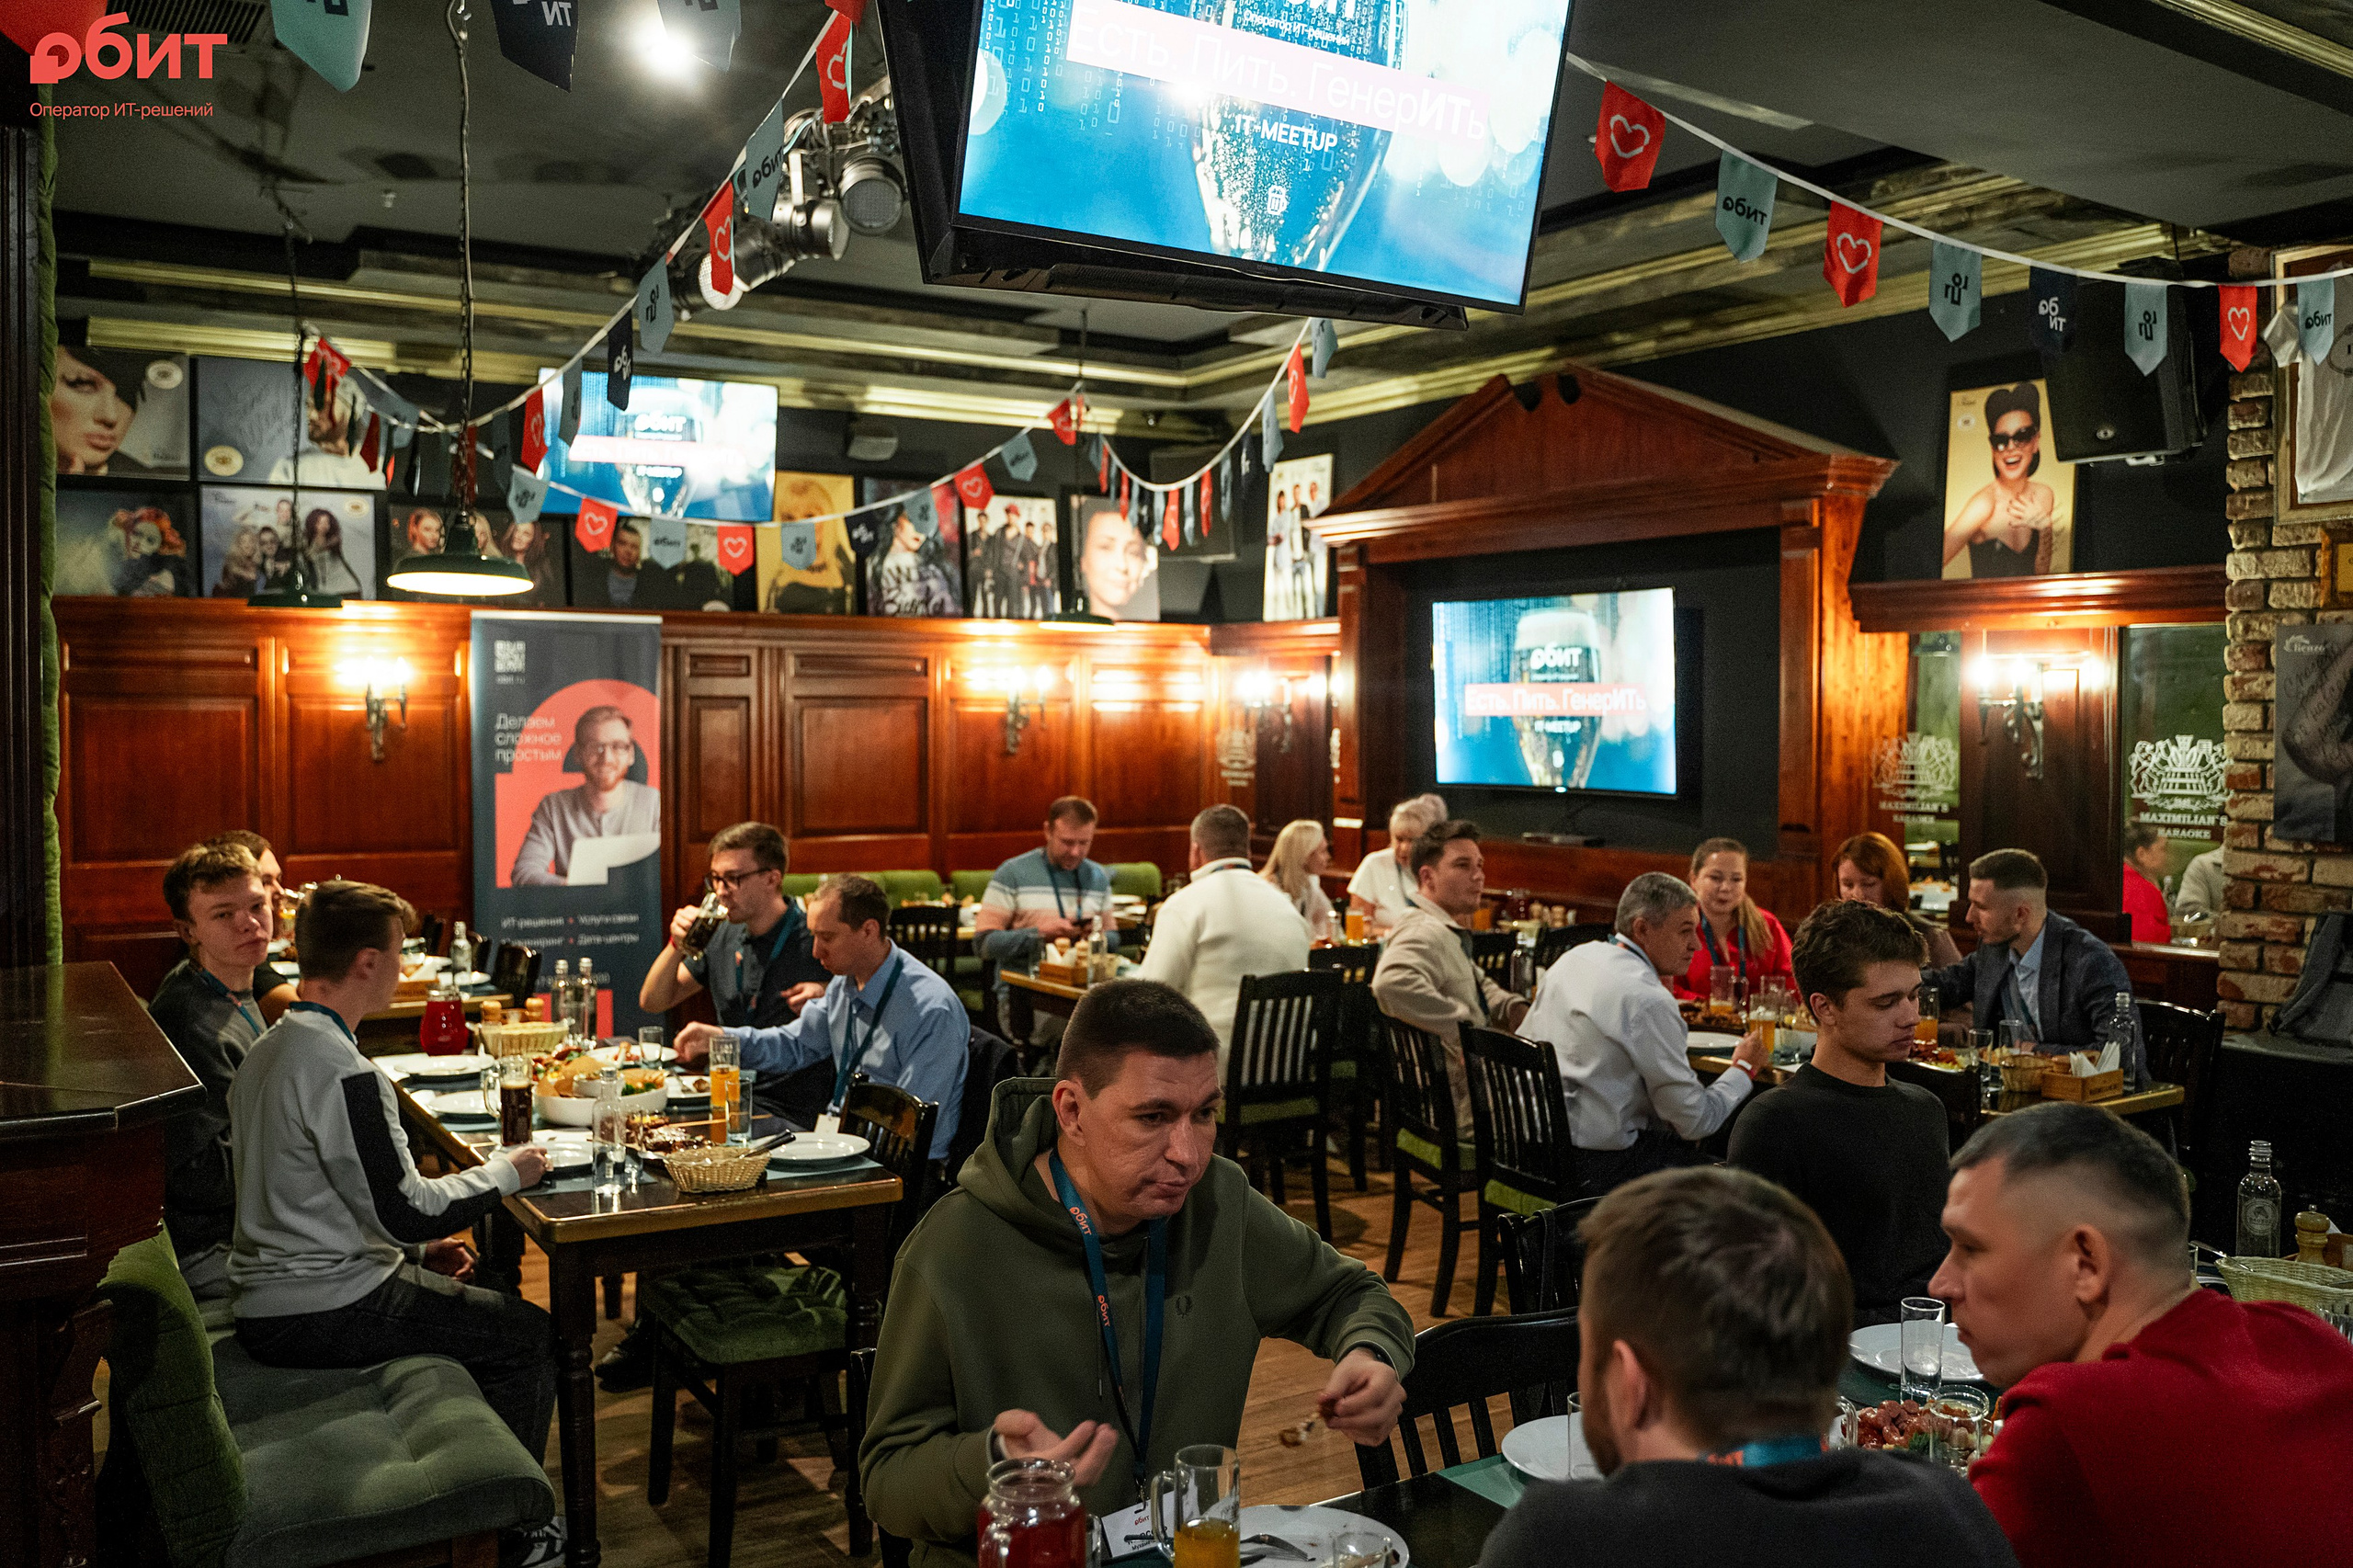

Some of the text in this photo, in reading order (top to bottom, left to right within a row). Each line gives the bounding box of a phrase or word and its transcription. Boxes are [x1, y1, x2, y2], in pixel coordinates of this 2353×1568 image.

[1243, 9, 1292, 33] Оператор
[1292, 21, 1351, 47] ИТ-решений
[1233, 112, 1339, 153] IT-MEETUP
[1722, 195, 1768, 226] обит
[1529, 643, 1583, 670] обит
[494, 713, 555, 732] Делаем
[494, 732, 563, 746] сложное
[494, 748, 563, 767] простым
[2139, 811, 2229, 827] MAXIMILIAN'S
[2156, 827, 2212, 840] KARAOKE
[1069, 1205, 1092, 1236] обит
[1097, 1294, 1111, 1328] обит
